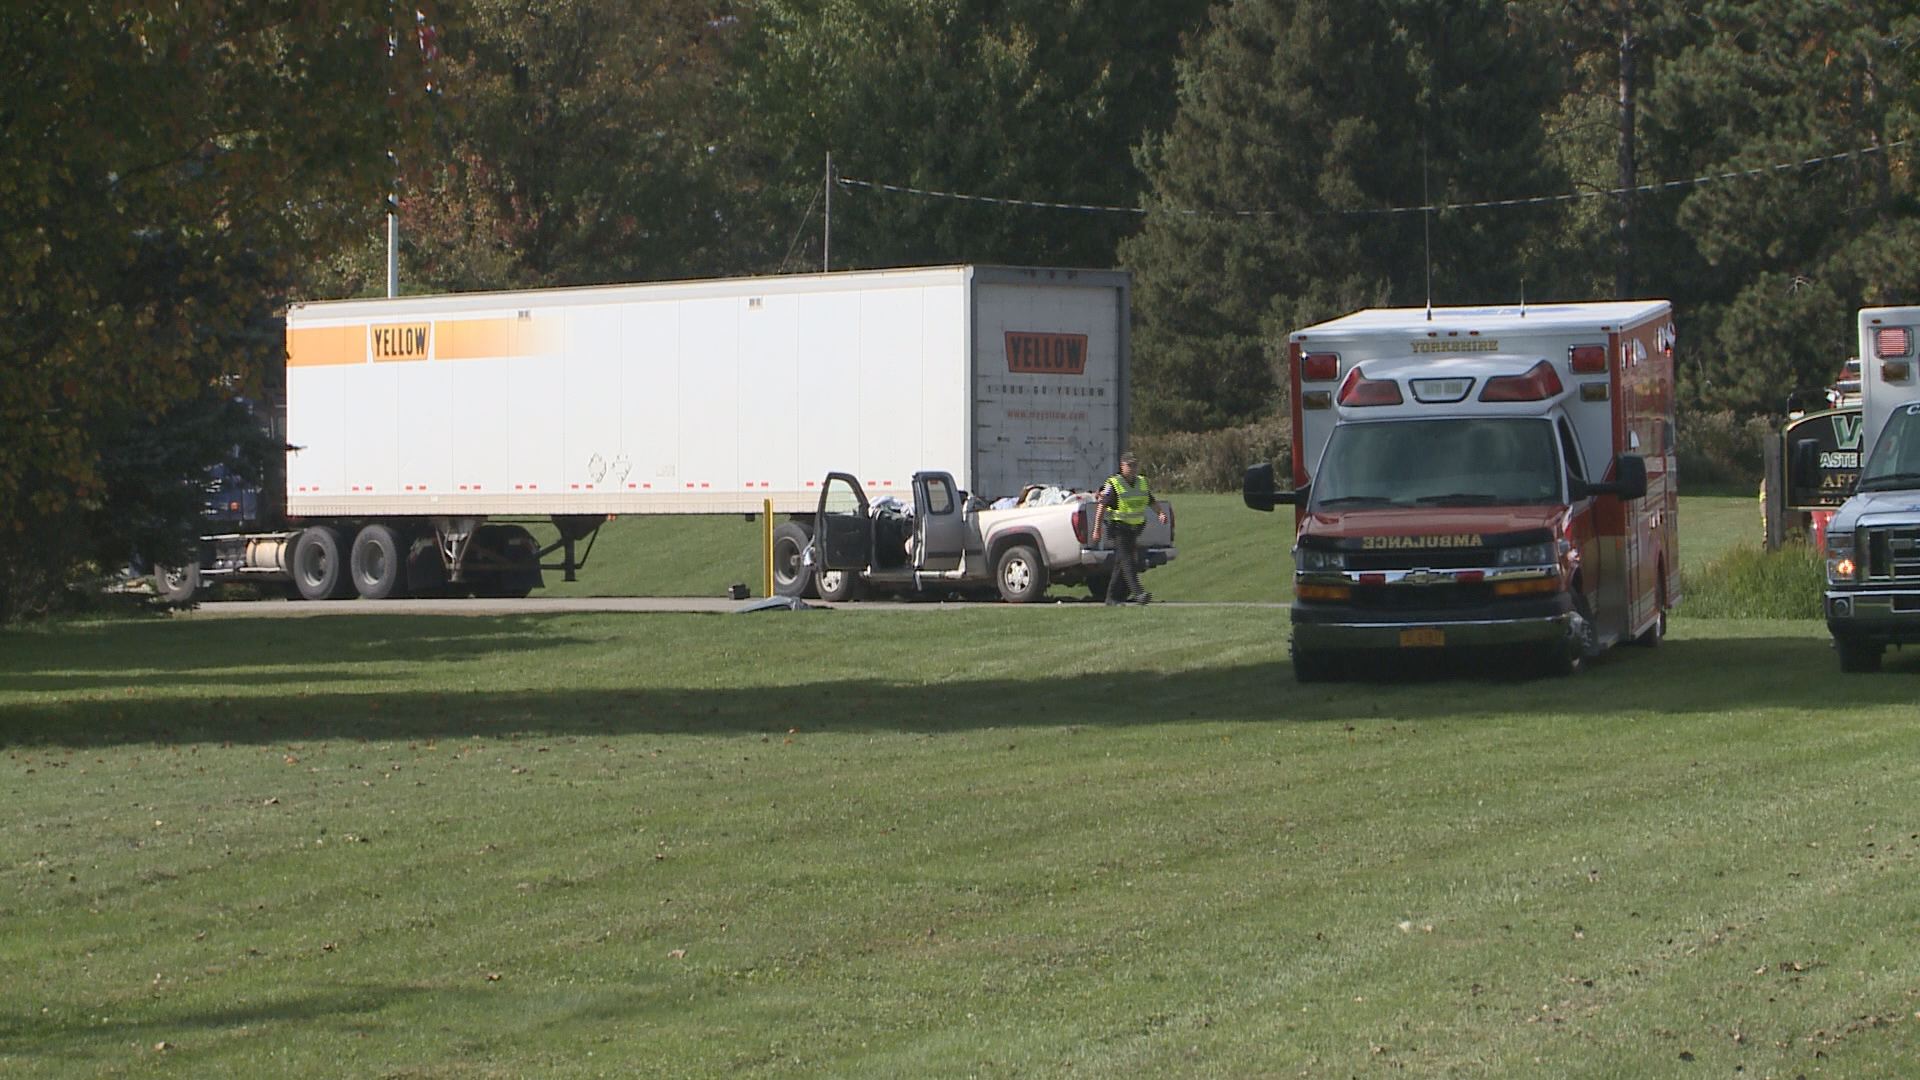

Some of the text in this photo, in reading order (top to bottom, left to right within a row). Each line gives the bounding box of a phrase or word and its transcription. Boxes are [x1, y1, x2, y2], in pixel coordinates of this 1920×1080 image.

[374, 327, 427, 357] YELLOW
[1010, 337, 1083, 368] YELLOW
[1410, 340, 1499, 353] YORKSHIRE
